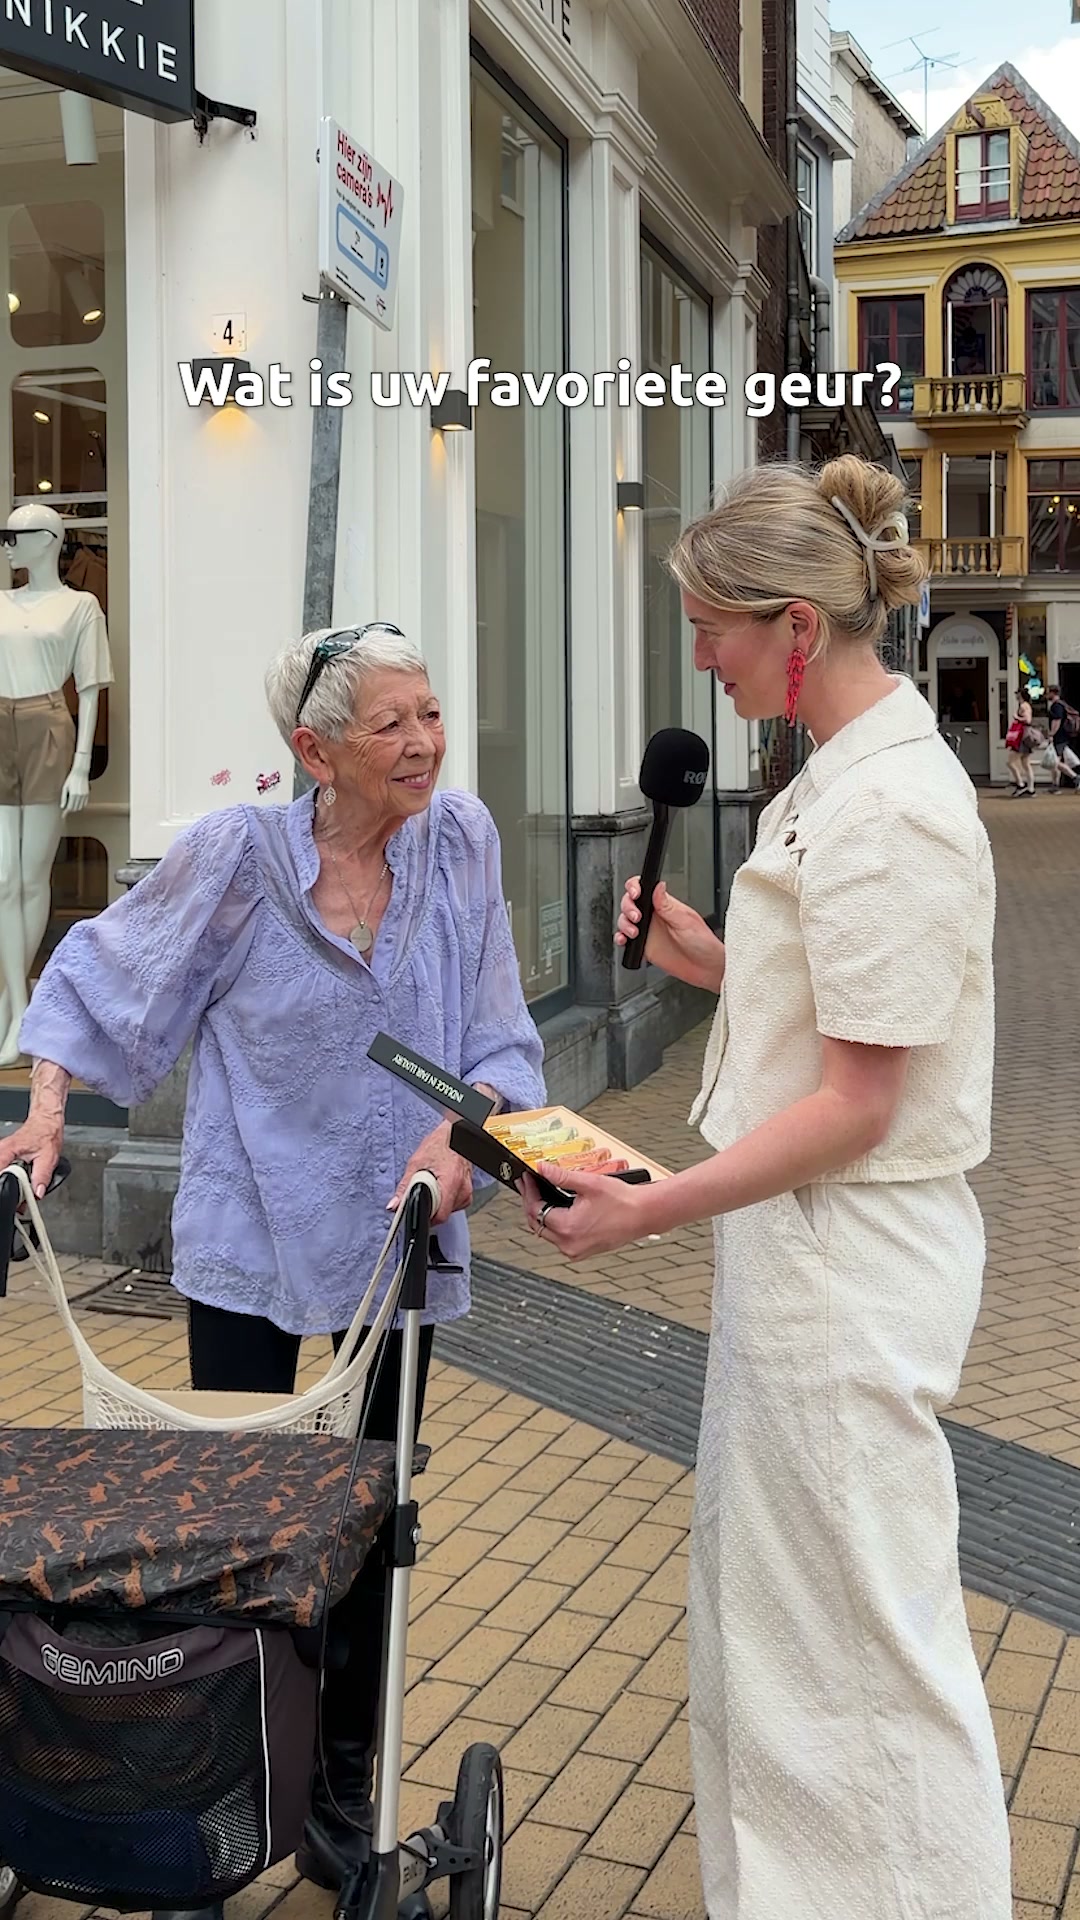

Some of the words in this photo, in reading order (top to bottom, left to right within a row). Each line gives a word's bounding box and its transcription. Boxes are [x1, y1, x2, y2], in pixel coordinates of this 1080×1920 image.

[5, 0, 178, 82] NIKKIE
[337, 129, 356, 165] Hier
[357, 153, 373, 183] zijn
[336, 162, 373, 208] camera's
[223, 319, 234, 345] 4
[392, 1053, 418, 1074] LUXURY
[435, 1080, 464, 1103] INDULGE
